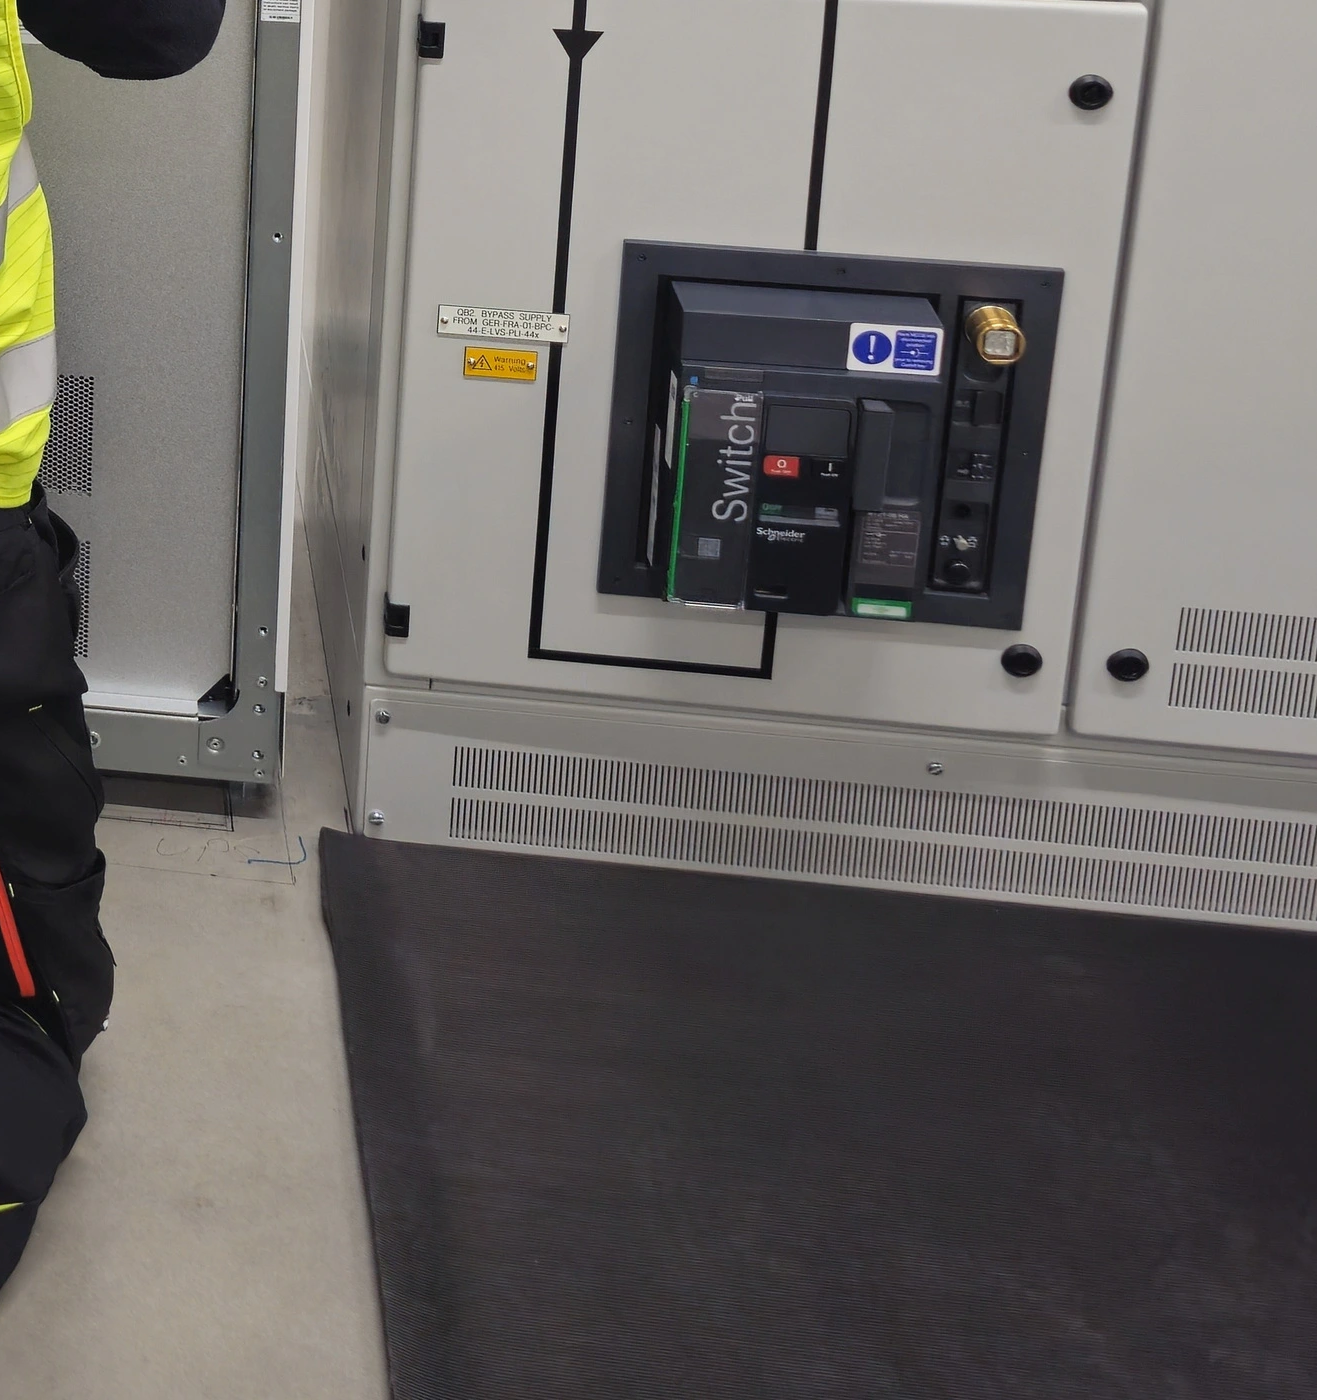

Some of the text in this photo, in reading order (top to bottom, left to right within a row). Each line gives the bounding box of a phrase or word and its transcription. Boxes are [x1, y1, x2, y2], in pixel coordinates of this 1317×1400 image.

[481, 310, 515, 320] BYPASS
[519, 313, 552, 323] SUPPLY
[452, 317, 555, 331] FROM GER-FRA-01-BPC-
[493, 355, 527, 366] Warning
[509, 365, 526, 373] Volts
[711, 403, 757, 522] Switch
[756, 527, 806, 539] Schneider
